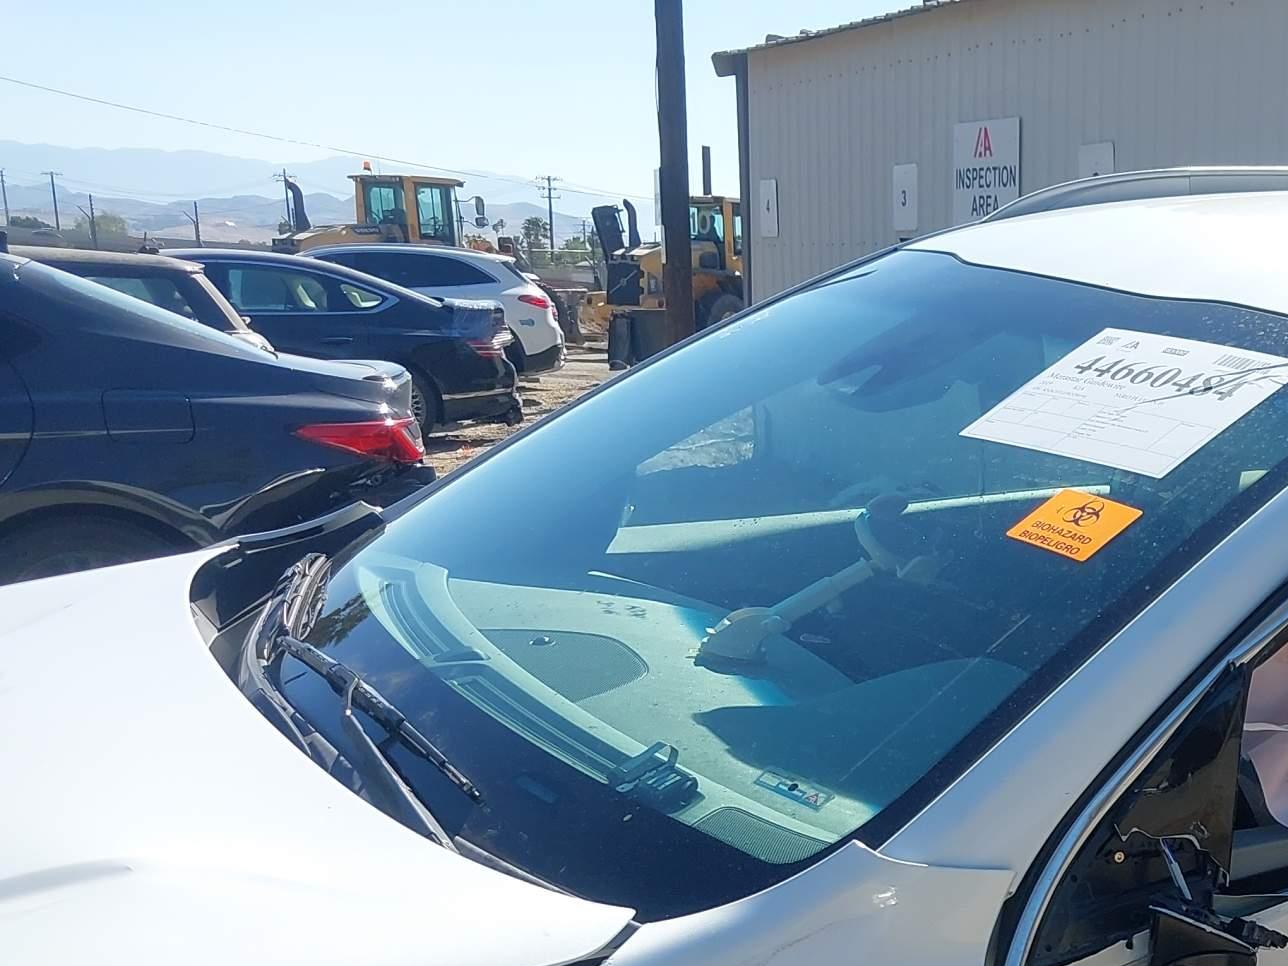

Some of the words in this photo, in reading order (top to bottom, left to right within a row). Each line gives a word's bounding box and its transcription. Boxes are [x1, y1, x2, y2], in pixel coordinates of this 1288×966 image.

[955, 165, 1016, 190] INSPECTION
[901, 190, 906, 206] 3
[971, 195, 999, 217] AREA
[1074, 356, 1245, 401] 44660484
[1019, 529, 1081, 556] BIOPELIGRO
[1031, 520, 1092, 545] BIOHAZARD
